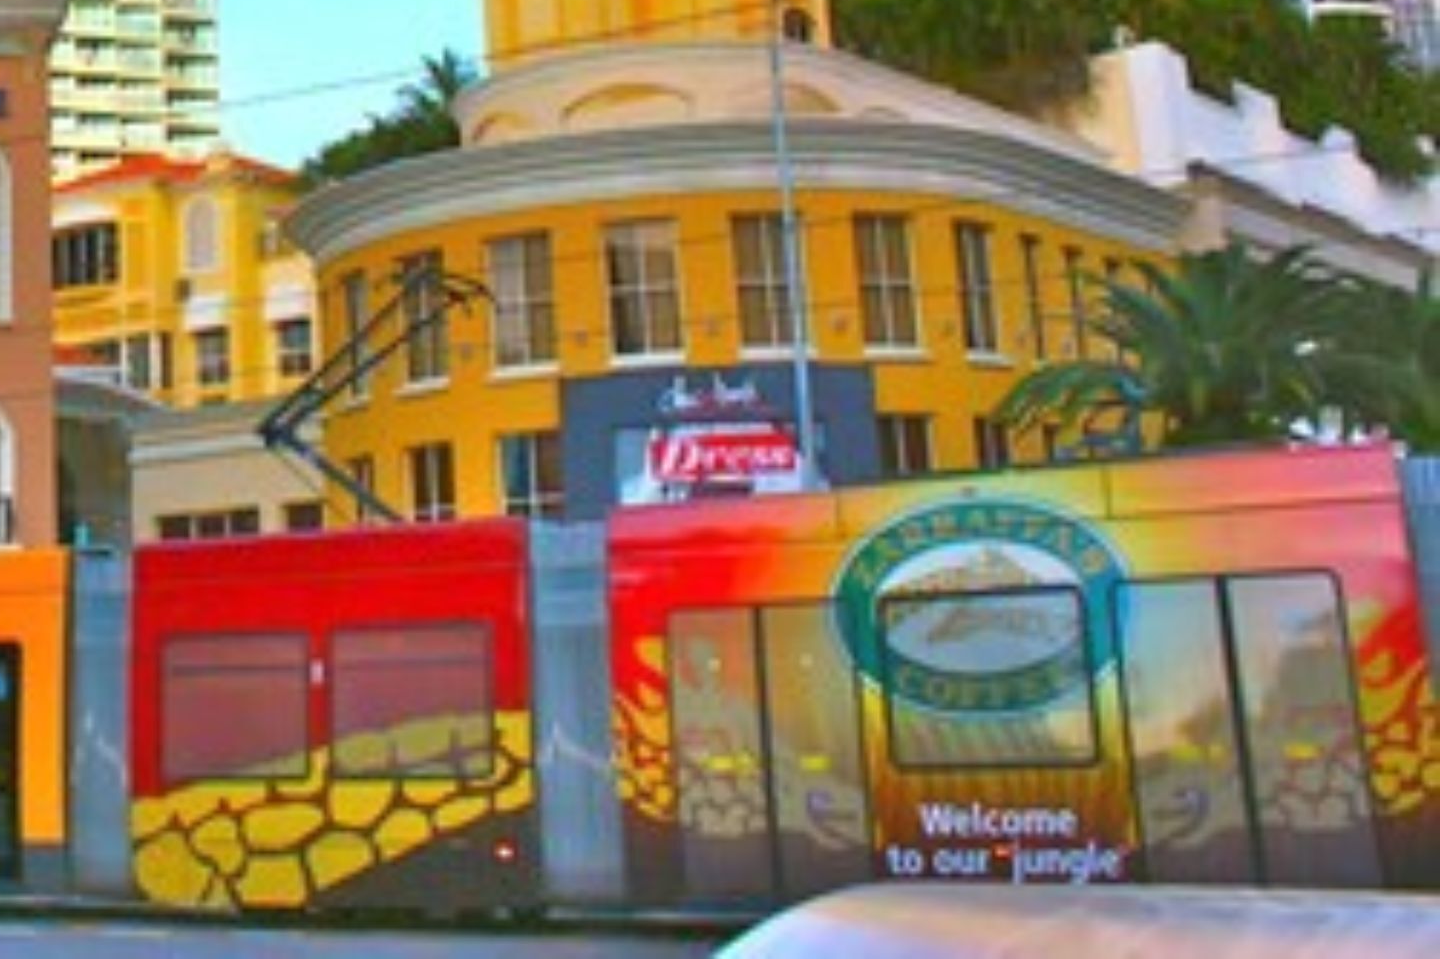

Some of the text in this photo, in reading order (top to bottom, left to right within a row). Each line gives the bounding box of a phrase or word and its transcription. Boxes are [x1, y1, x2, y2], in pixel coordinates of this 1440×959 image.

[919, 803, 1076, 835] Welcome
[886, 846, 923, 874] to
[933, 848, 988, 874] our
